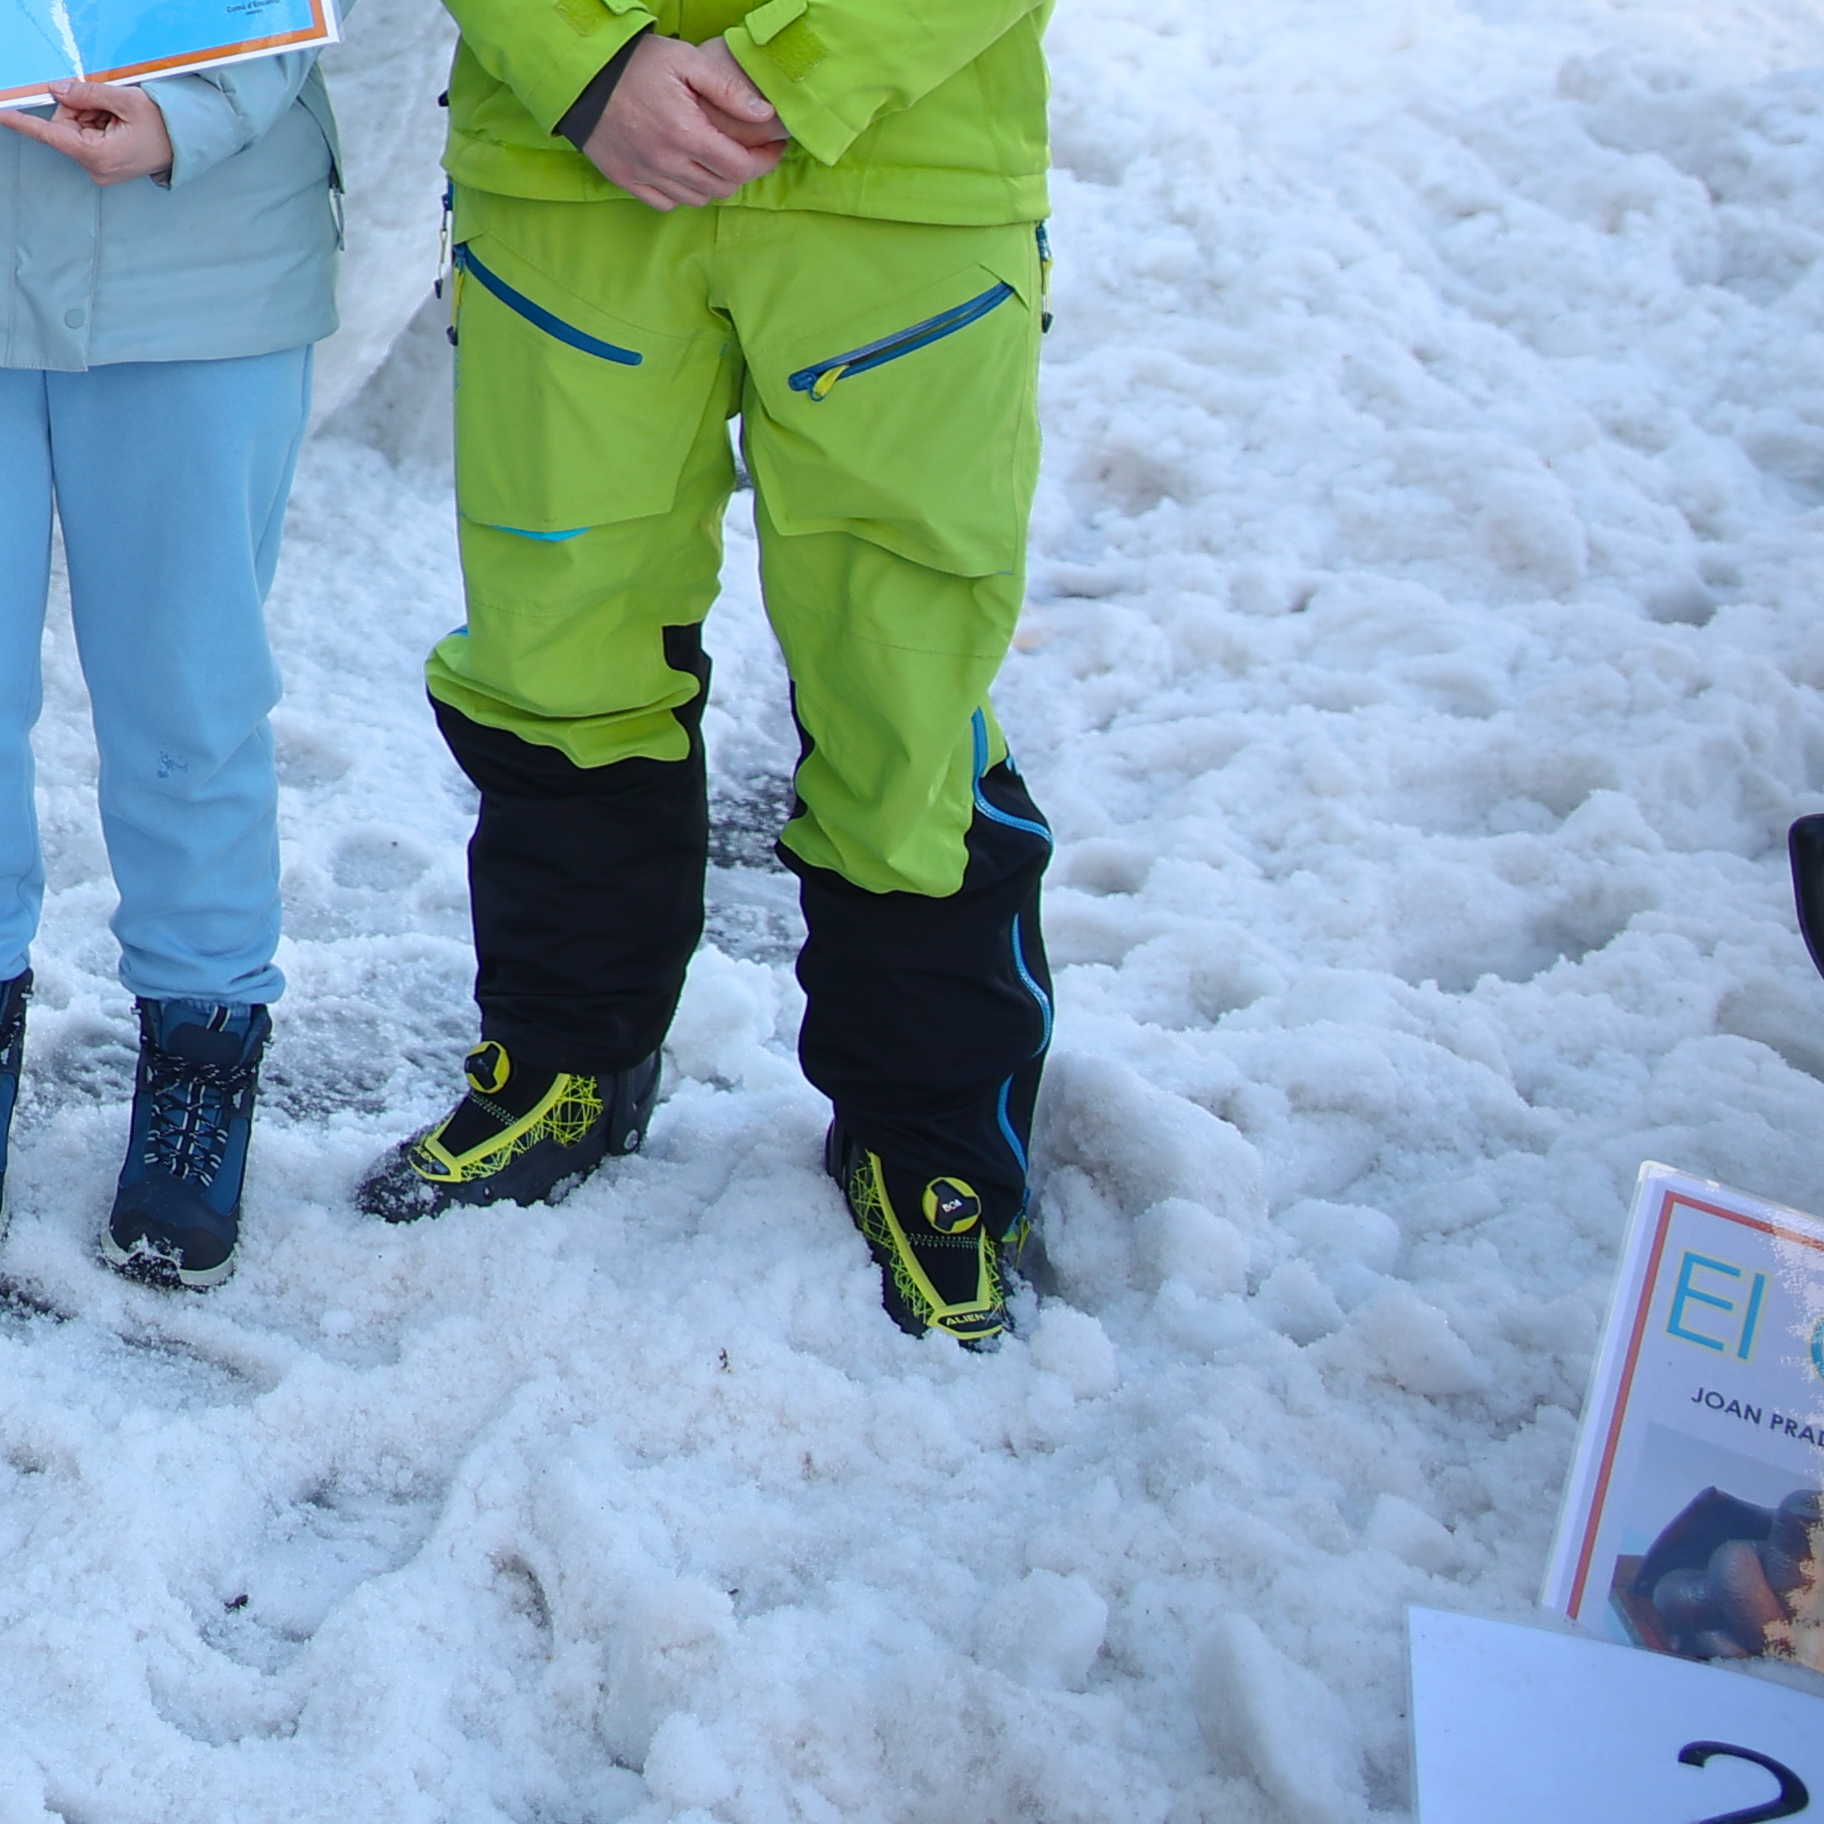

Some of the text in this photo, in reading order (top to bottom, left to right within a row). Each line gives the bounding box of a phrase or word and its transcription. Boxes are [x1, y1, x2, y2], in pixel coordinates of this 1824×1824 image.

[941, 1198, 963, 1213] BOA
[946, 1312, 986, 1326] ALIEN
[1665, 1250, 1766, 1362] El
[1690, 1386, 1762, 1425] JOAN
